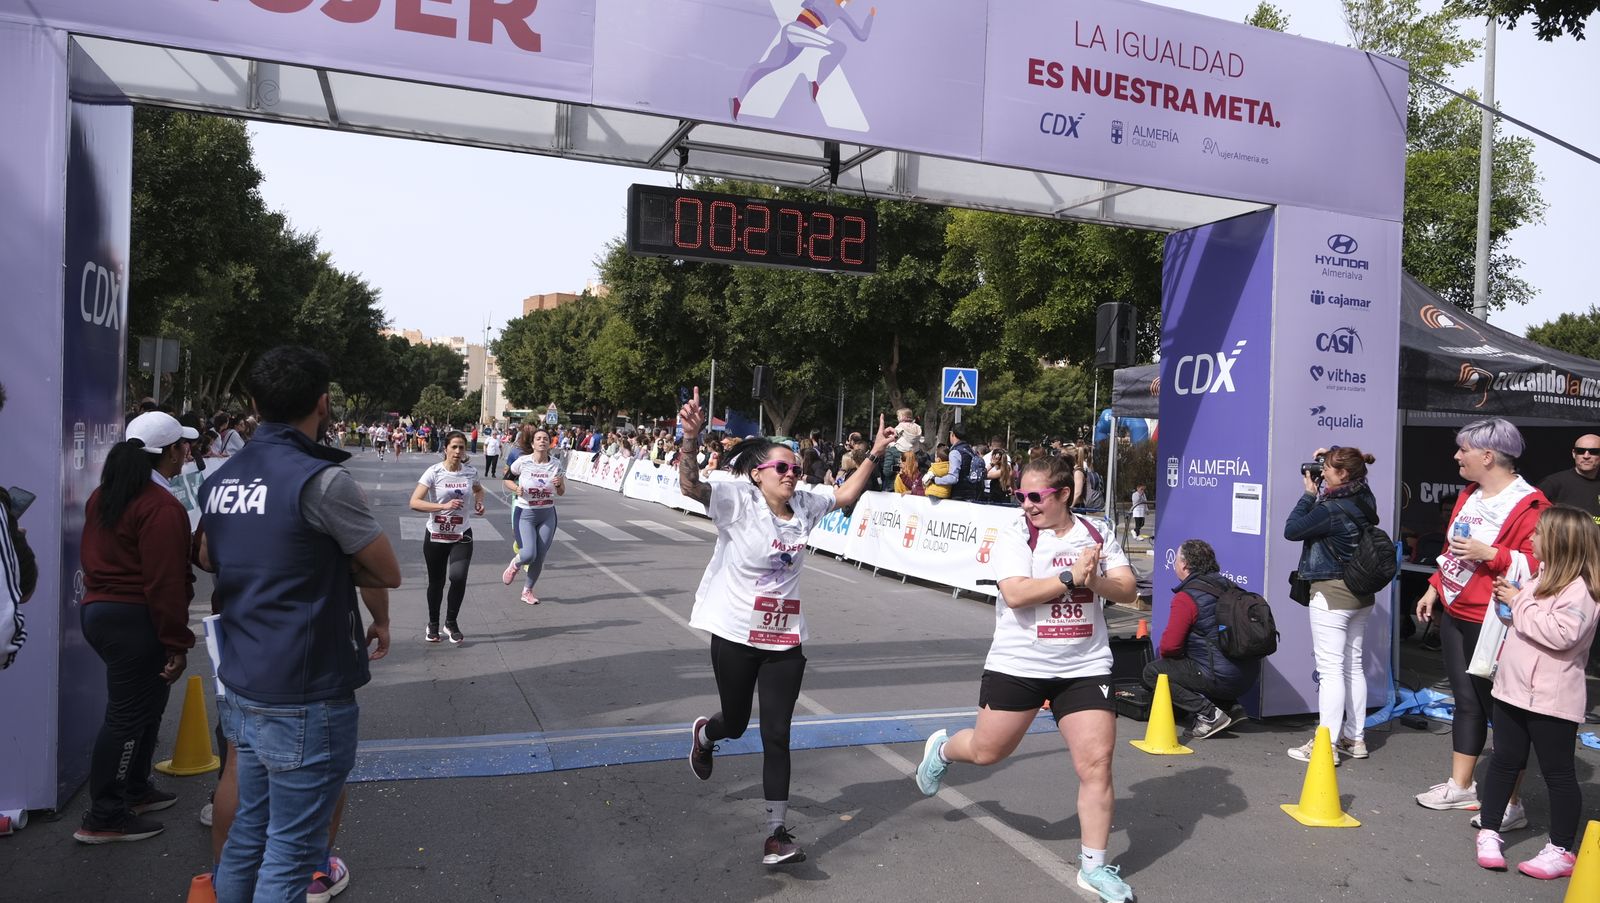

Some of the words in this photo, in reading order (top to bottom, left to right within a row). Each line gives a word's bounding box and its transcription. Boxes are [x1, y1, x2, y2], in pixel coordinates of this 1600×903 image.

[1074, 20, 1107, 52] LA
[1115, 28, 1245, 79] IGUALDAD
[1027, 57, 1065, 89] ES
[1070, 64, 1199, 116] NUESTRA
[1203, 91, 1281, 129] META.
[1039, 112, 1083, 139] CDX
[1132, 123, 1180, 145] ALMERÍA
[1131, 138, 1157, 149] CIUDAD
[673, 196, 867, 265] 00:27:22
[1314, 254, 1369, 271] HYUNDAI
[80, 260, 121, 331] CDX
[1327, 293, 1372, 308] cajamar
[1315, 331, 1354, 355] CASI
[1174, 346, 1242, 396] CDX
[1327, 368, 1367, 384] vithas
[1317, 413, 1364, 431] aqualia
[1188, 456, 1251, 477] ALMERÍA
[1188, 476, 1218, 488] CIUDAD
[439, 523, 457, 532] 687
[925, 520, 978, 544] ALMERÍA
[921, 540, 950, 554] CIUDAD
[1442, 560, 1465, 578] 627
[762, 612, 788, 628] 911
[1050, 603, 1083, 619] 836
